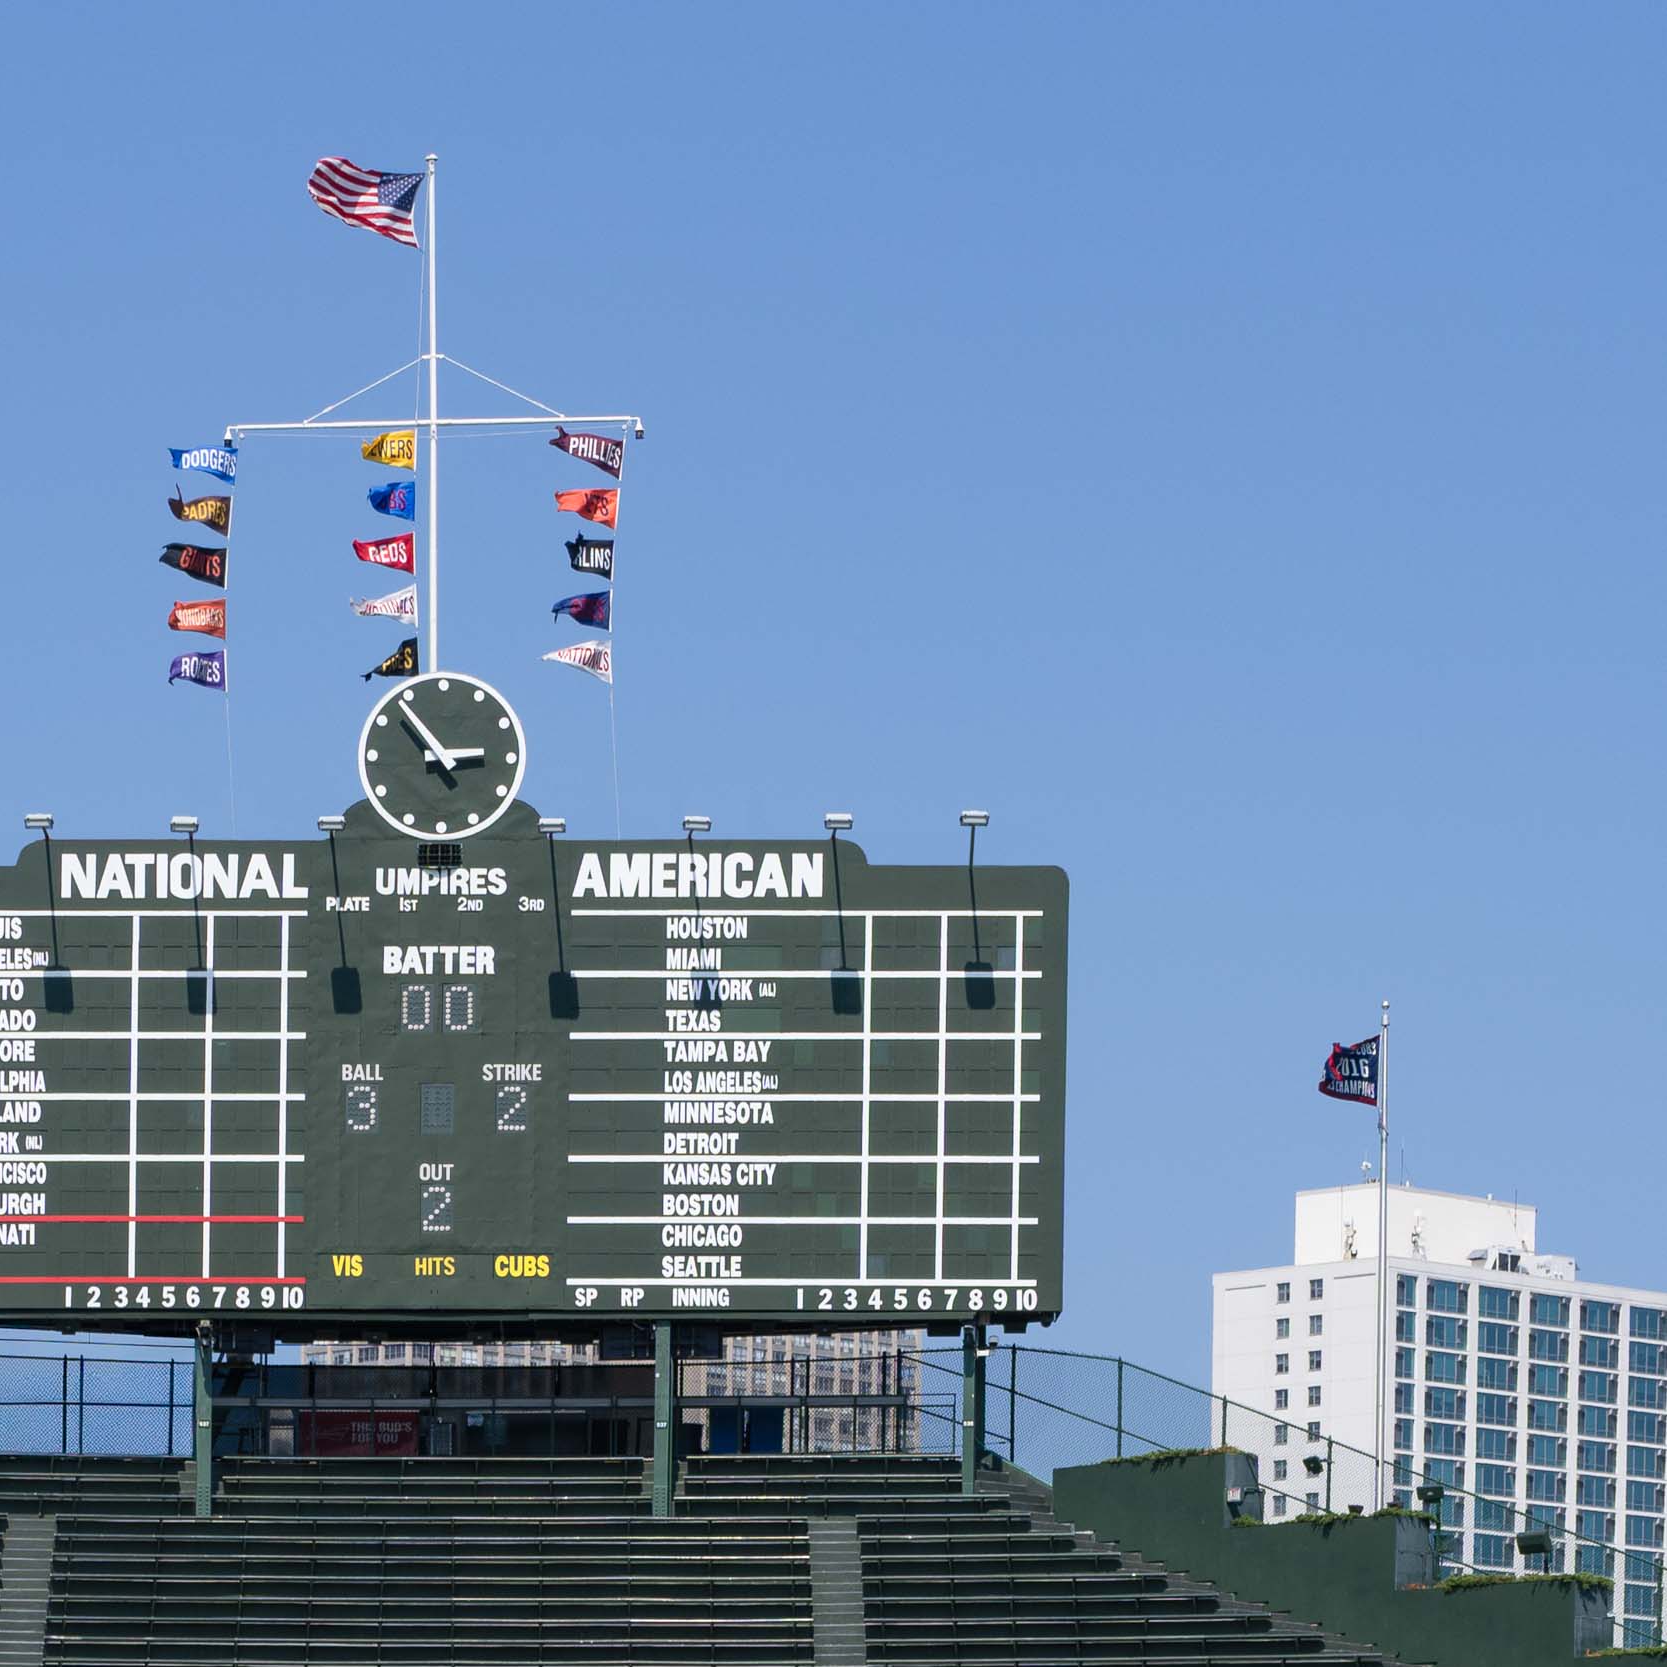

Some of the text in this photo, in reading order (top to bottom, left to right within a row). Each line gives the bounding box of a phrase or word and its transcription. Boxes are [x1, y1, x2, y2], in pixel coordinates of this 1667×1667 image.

[182, 449, 237, 476] DODGERS
[569, 437, 621, 468] PHILLIES
[182, 500, 227, 525] PADRES
[368, 543, 407, 563] REDS
[60, 853, 308, 900] NATIONAL
[376, 868, 508, 895] UMPIRES
[572, 852, 824, 898] AMERICAN
[326, 897, 544, 912] PLATE 1ST 2ND 3RD
[666, 917, 748, 939] HOUSTON
[383, 946, 495, 975] BATTER
[666, 948, 721, 970] MIAMI
[666, 979, 703, 1001] NEW
[706, 979, 752, 1001] YORK
[666, 1010, 721, 1031] TEXAS
[664, 1041, 771, 1062] TAMPA BAY
[342, 1064, 384, 1082] BALL
[482, 1063, 542, 1081] STRIKE
[664, 1072, 692, 1093] LOS
[697, 1071, 761, 1093] ANGELES
[347, 1086, 377, 1131] 3
[497, 1086, 527, 1132] 2
[664, 1103, 774, 1124] MINNESOTA
[663, 1133, 739, 1155] DETROIT
[419, 1163, 454, 1182] OUT
[663, 1164, 776, 1186] KANSAS CITY
[422, 1186, 450, 1232] 2
[663, 1195, 739, 1216] BOSTON
[662, 1225, 742, 1247] CHICAGO
[333, 1256, 549, 1277] VIS HITS CUBS
[662, 1256, 742, 1277] SEATTLE
[65, 1287, 71, 1308] 1
[88, 1287, 101, 1308] 2
[114, 1287, 128, 1308] 3
[135, 1287, 150, 1308] 4
[162, 1287, 176, 1308] 5
[186, 1287, 199, 1308] 6
[213, 1287, 226, 1308] 7
[236, 1287, 250, 1308] 8
[261, 1287, 275, 1308] 9
[283, 1287, 303, 1309] 10
[575, 1288, 1037, 1310] SP RP INNING 1 2 3 4 5 6 7 8 9 10
